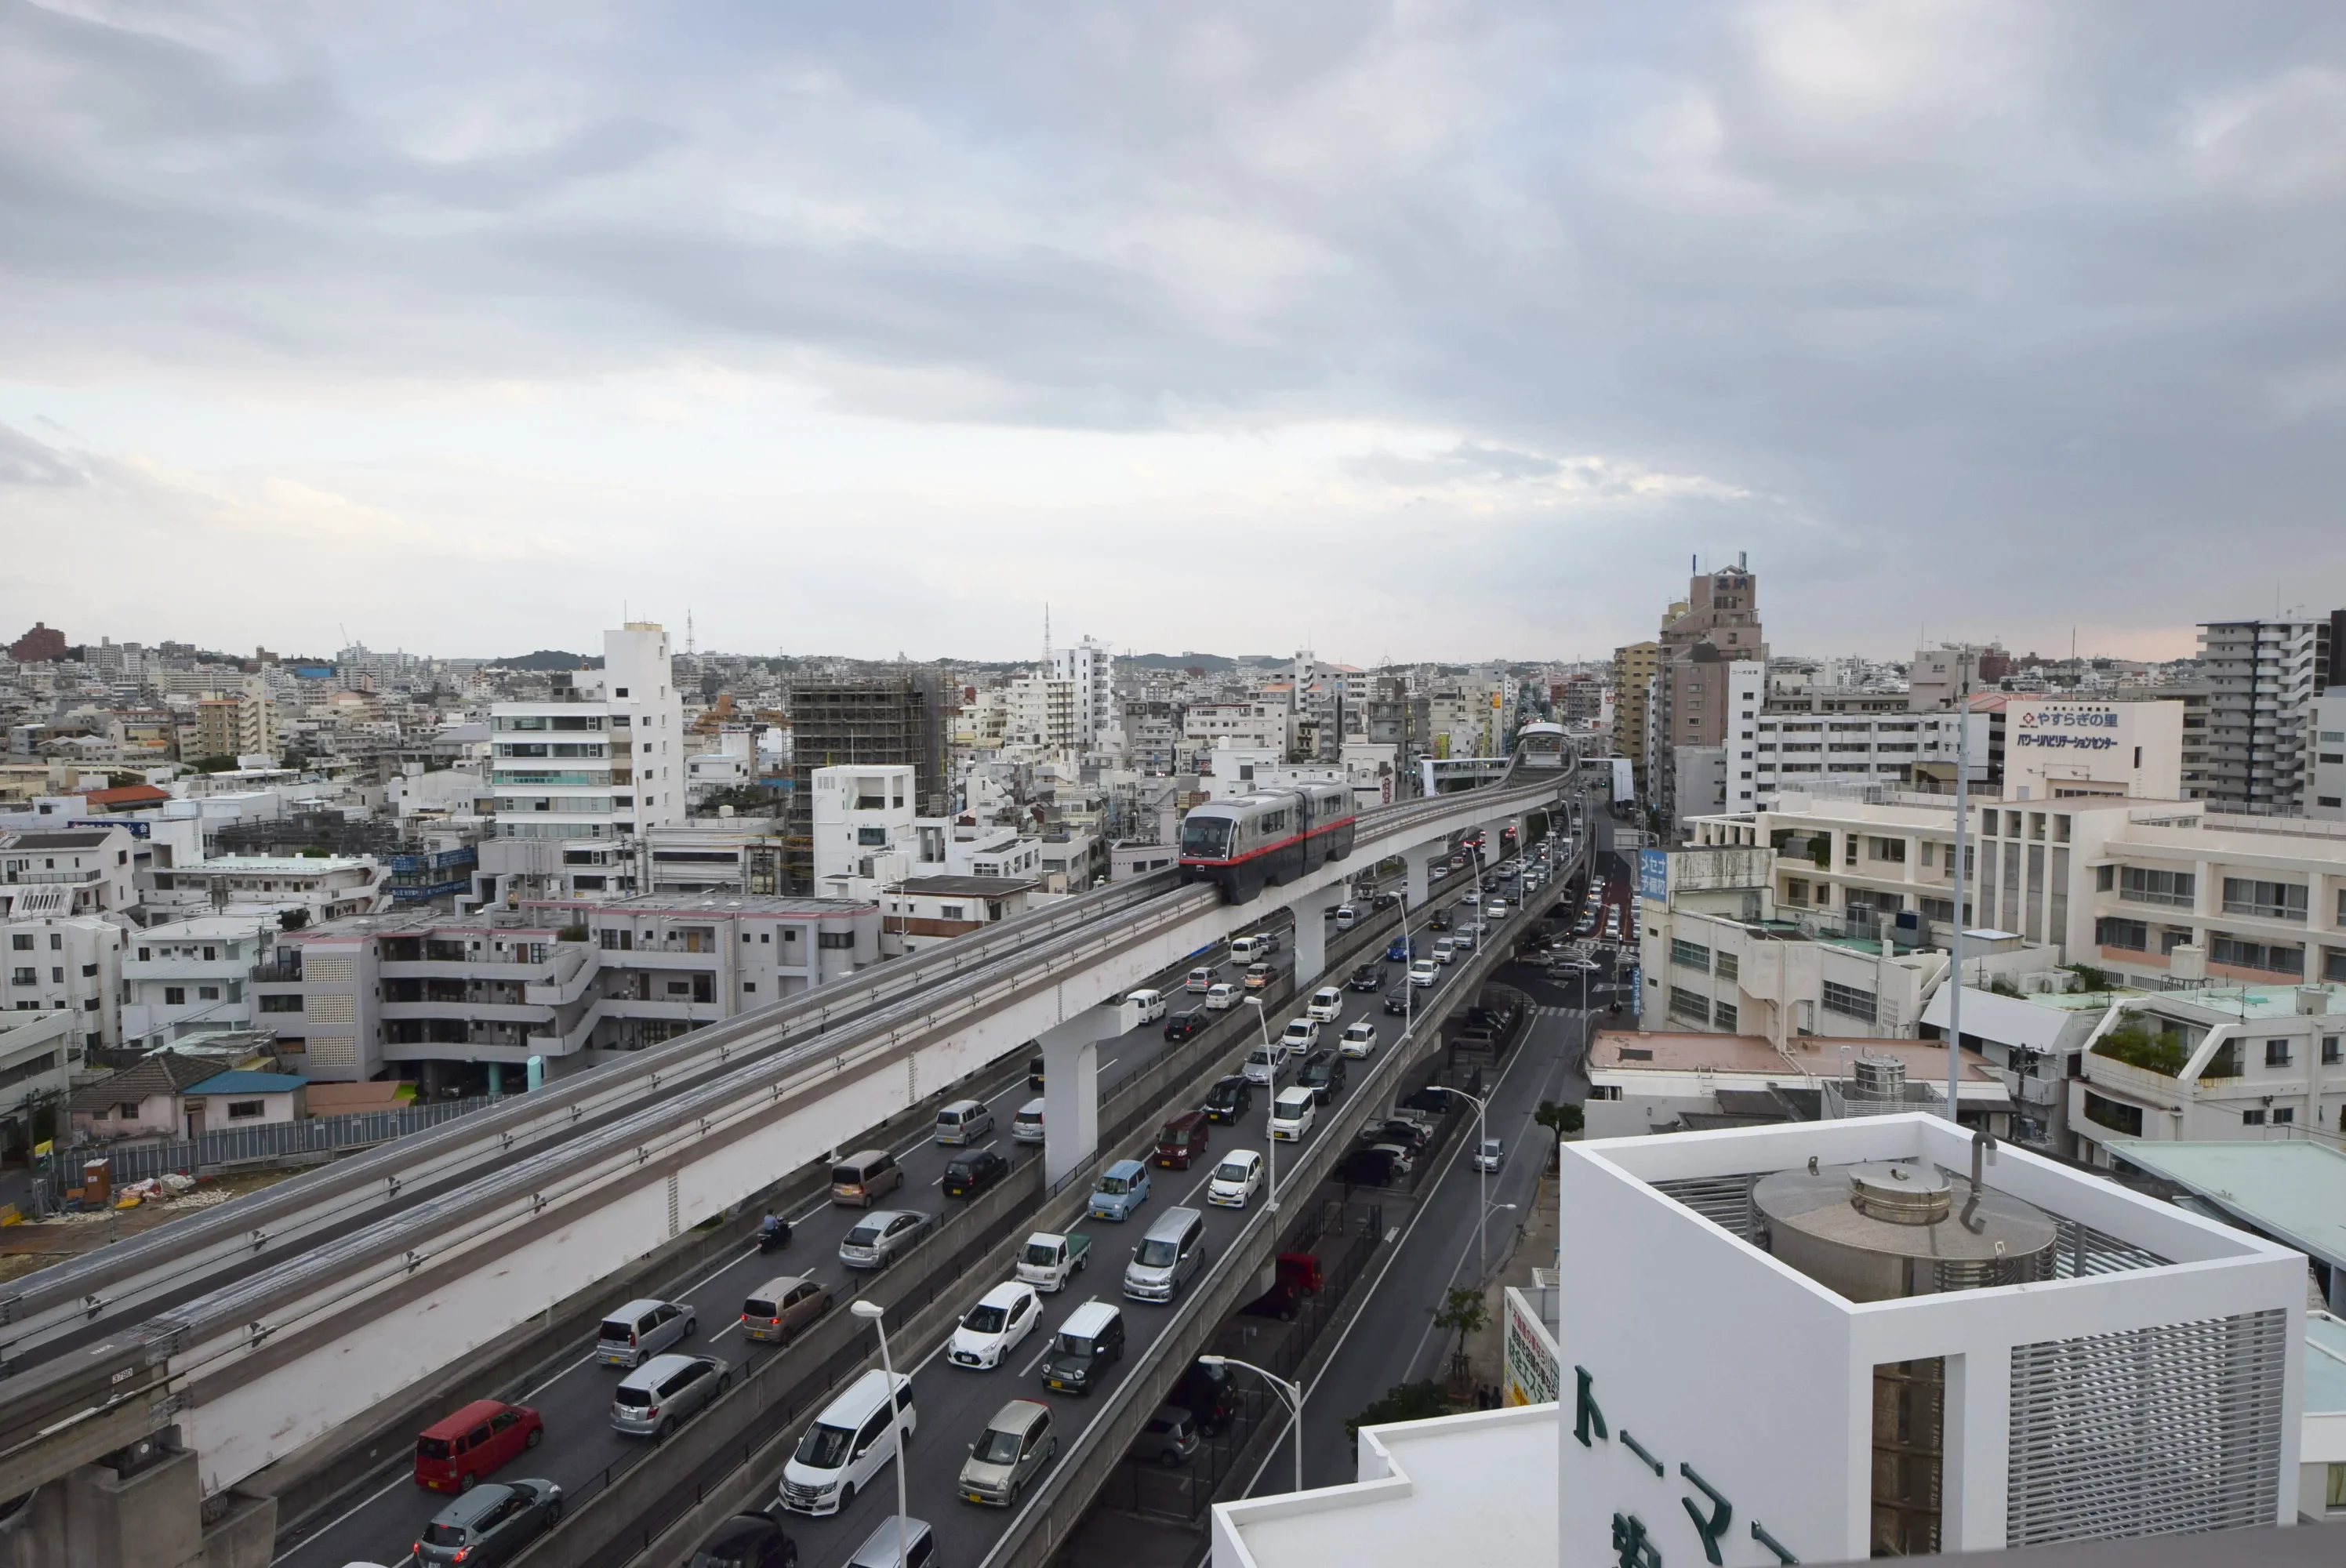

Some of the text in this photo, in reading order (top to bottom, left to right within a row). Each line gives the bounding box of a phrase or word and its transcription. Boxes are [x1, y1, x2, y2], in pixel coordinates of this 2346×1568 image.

[2037, 713, 2118, 728] やすらぎの里
[2017, 734, 2118, 750] パワーリハビリテーションセンター
[1641, 855, 1665, 874] メセナ
[1641, 875, 1665, 895] 予備校
[1509, 1336, 1546, 1403] 財全エステ
[1573, 1364, 1799, 1566] トーマ
